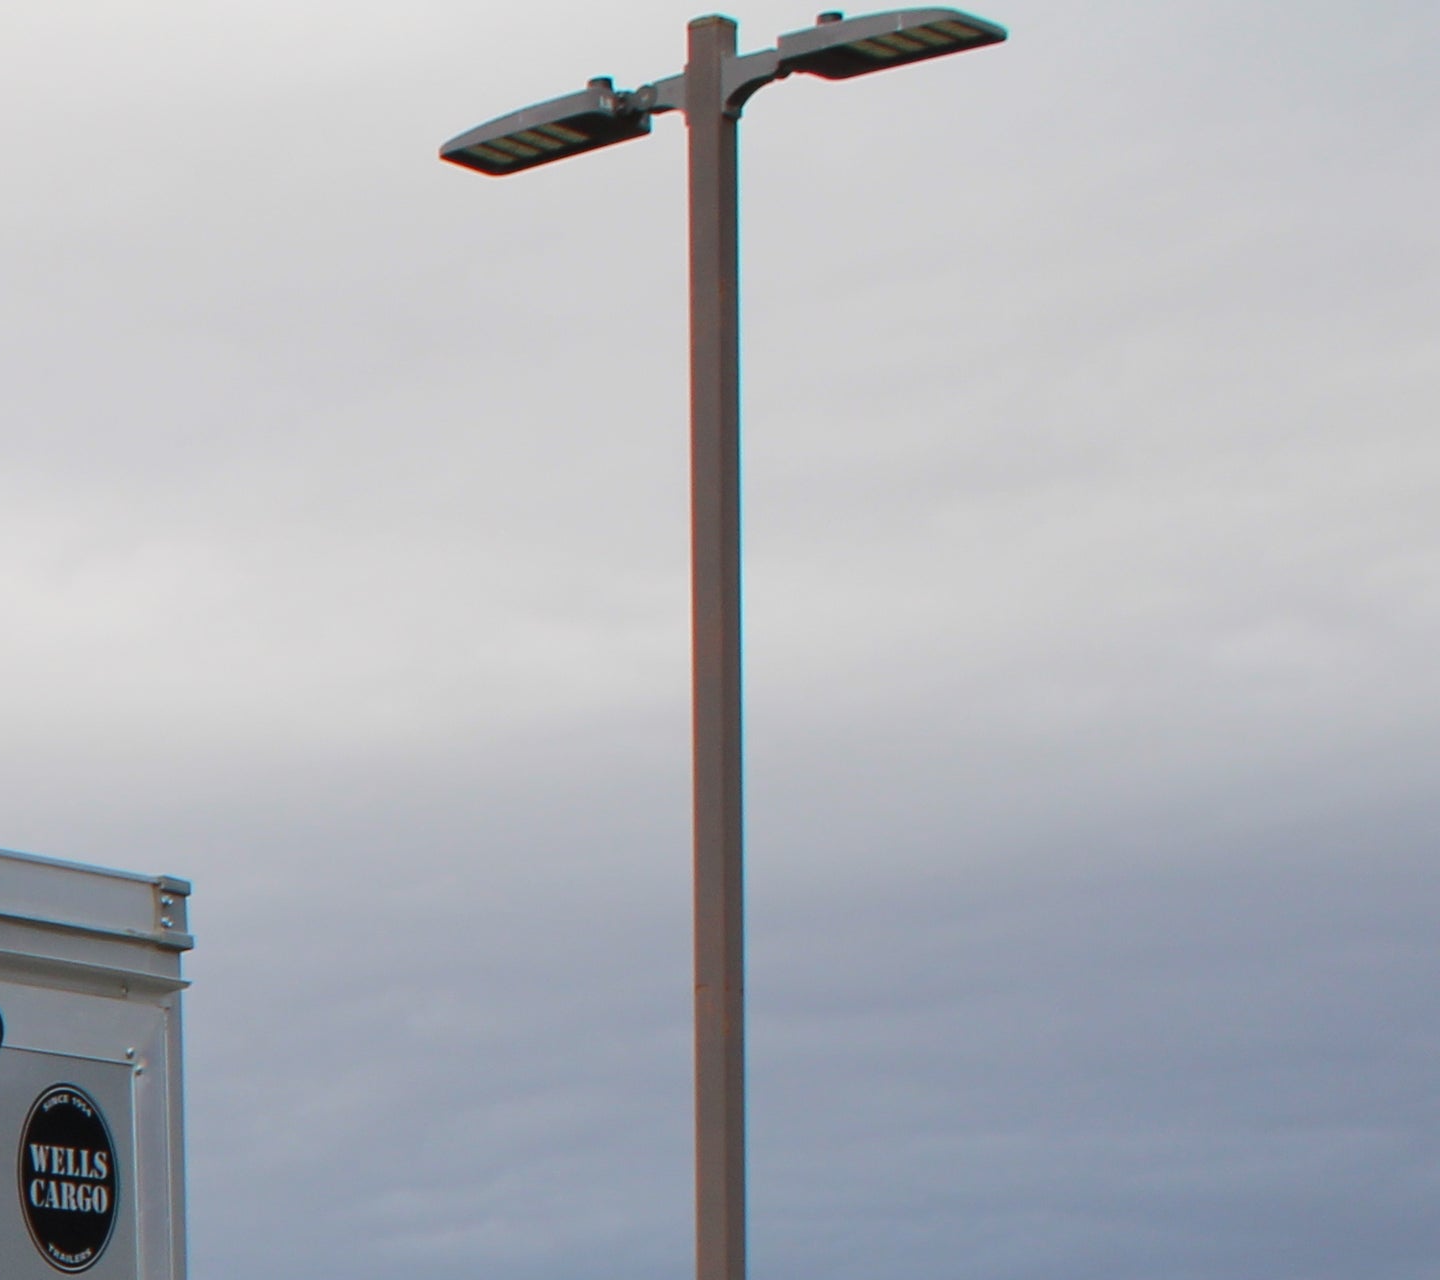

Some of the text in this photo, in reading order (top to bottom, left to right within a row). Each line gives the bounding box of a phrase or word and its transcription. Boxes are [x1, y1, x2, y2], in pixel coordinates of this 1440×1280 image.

[30, 1143, 107, 1180] WELLS
[30, 1178, 108, 1213] CARGO
[48, 1242, 92, 1264] TRAILERS
